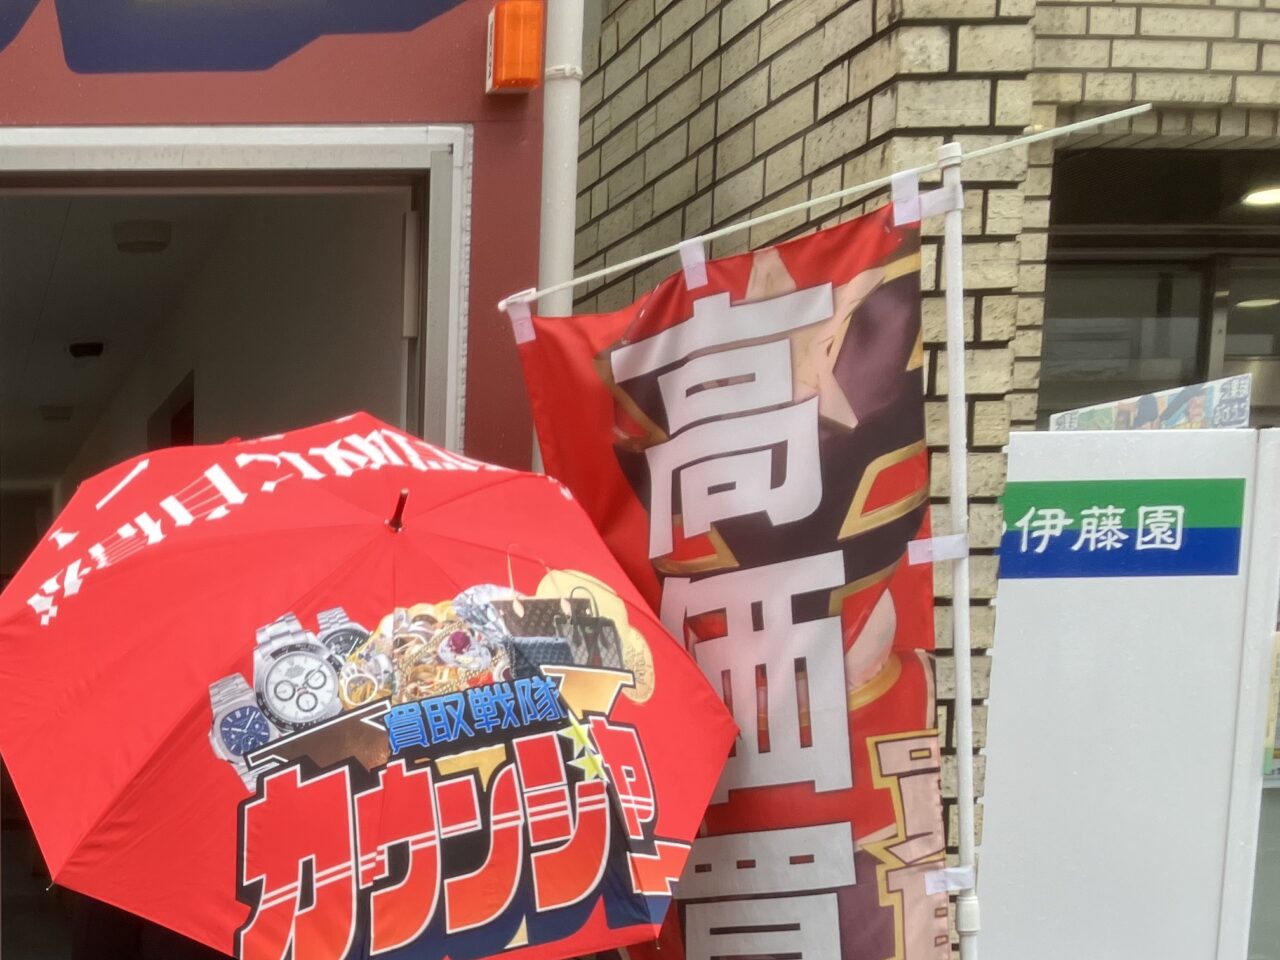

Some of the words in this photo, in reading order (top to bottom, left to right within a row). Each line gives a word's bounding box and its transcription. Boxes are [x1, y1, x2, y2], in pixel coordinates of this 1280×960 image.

[1015, 504, 1185, 553] 伊藤園
[384, 673, 568, 754] 買取戦隊
